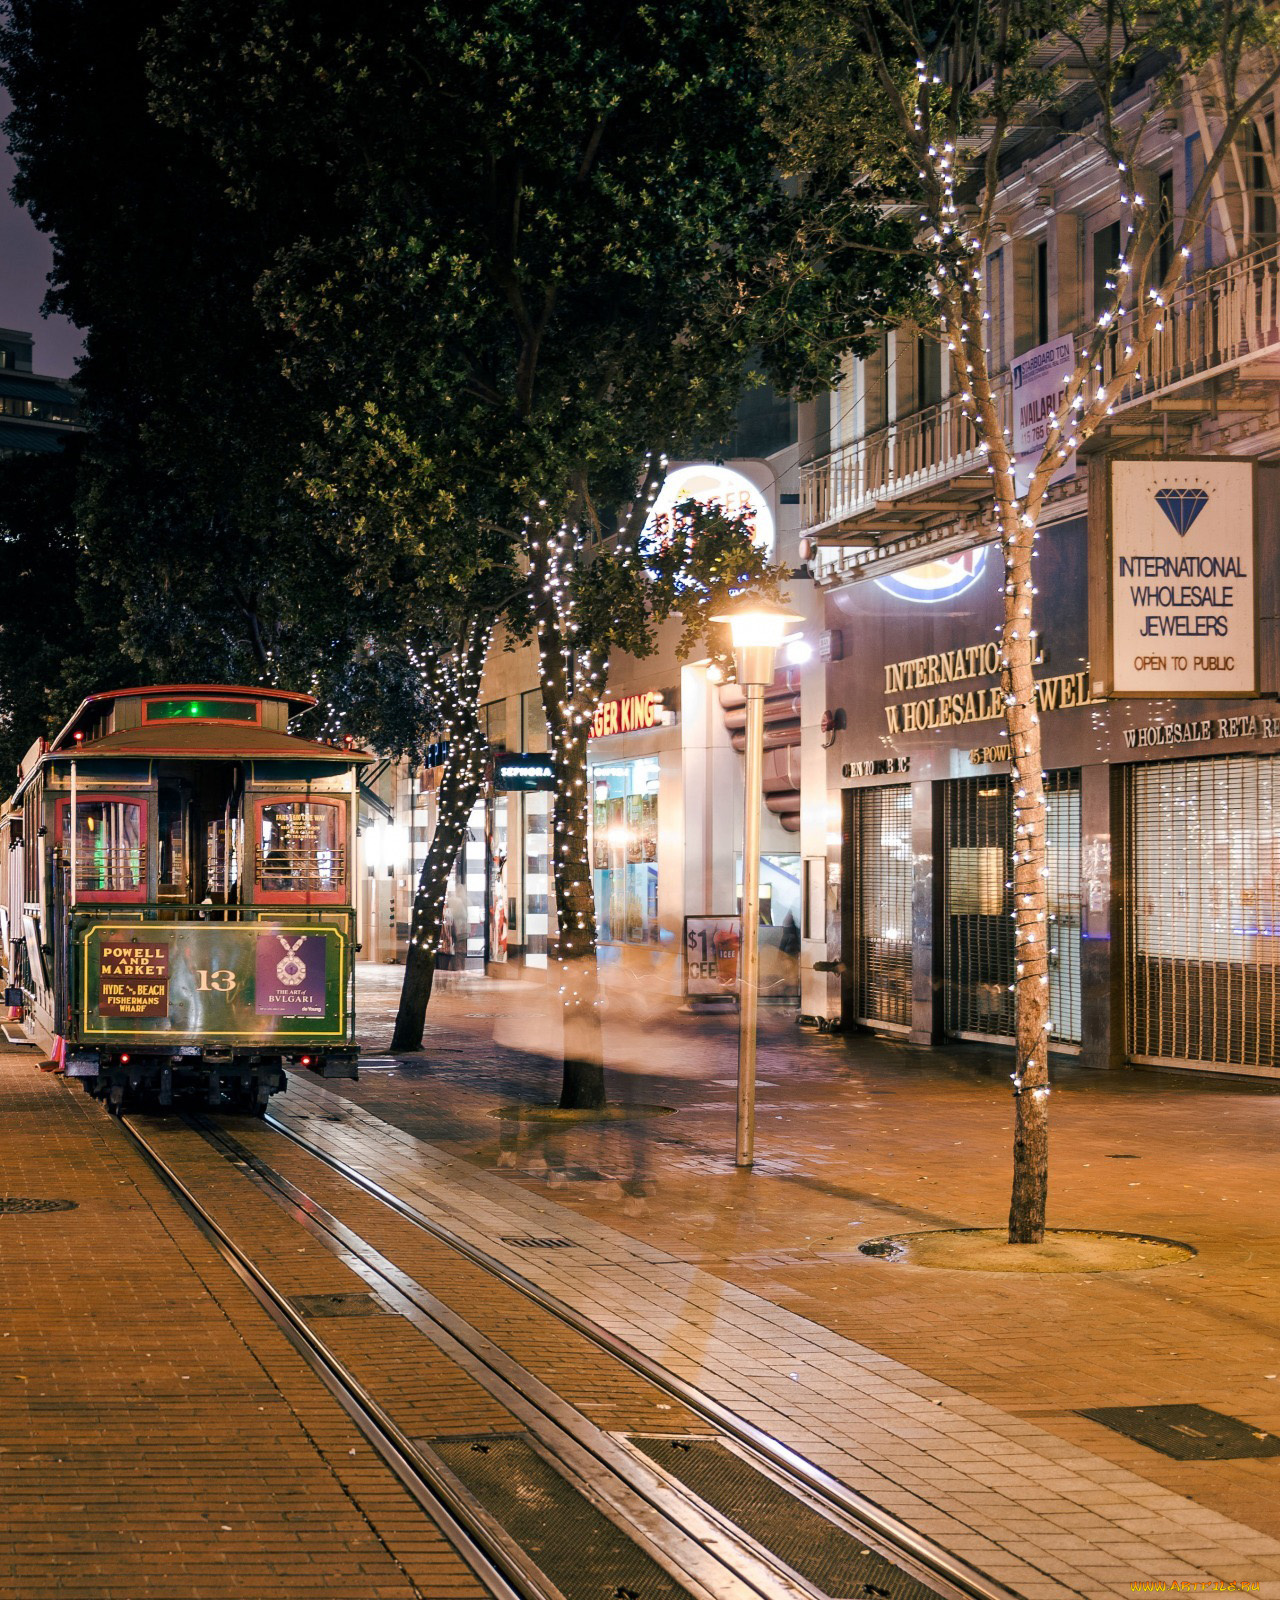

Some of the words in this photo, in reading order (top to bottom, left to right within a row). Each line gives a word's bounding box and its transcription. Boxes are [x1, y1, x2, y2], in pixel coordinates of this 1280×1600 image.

[1021, 349, 1055, 375] STARBOARD
[1056, 344, 1070, 359] TCN
[1119, 556, 1247, 578] INTERNATIONAL
[1130, 586, 1233, 607] WHOLESALE
[1140, 615, 1228, 636] JEWELERS
[1134, 656, 1167, 671] OPEN
[1171, 656, 1187, 671] TO
[1194, 656, 1235, 671] PUBLIC
[621, 691, 654, 732] KING
[885, 687, 1004, 734] WHOLESALE
[1123, 720, 1211, 749] WHOLESALE
[501, 766, 552, 777] SEPHORA
[103, 948, 165, 958] POWELL
[688, 929, 708, 961] $1
[720, 950, 736, 958] ICEE
[101, 965, 165, 975] MARKET
[103, 984, 124, 995] HYDE
[137, 985, 165, 995] BEACH
[196, 970, 236, 992] 13
[107, 996, 159, 1005] FISHERMANS
[268, 995, 313, 1003] BVLGARI
